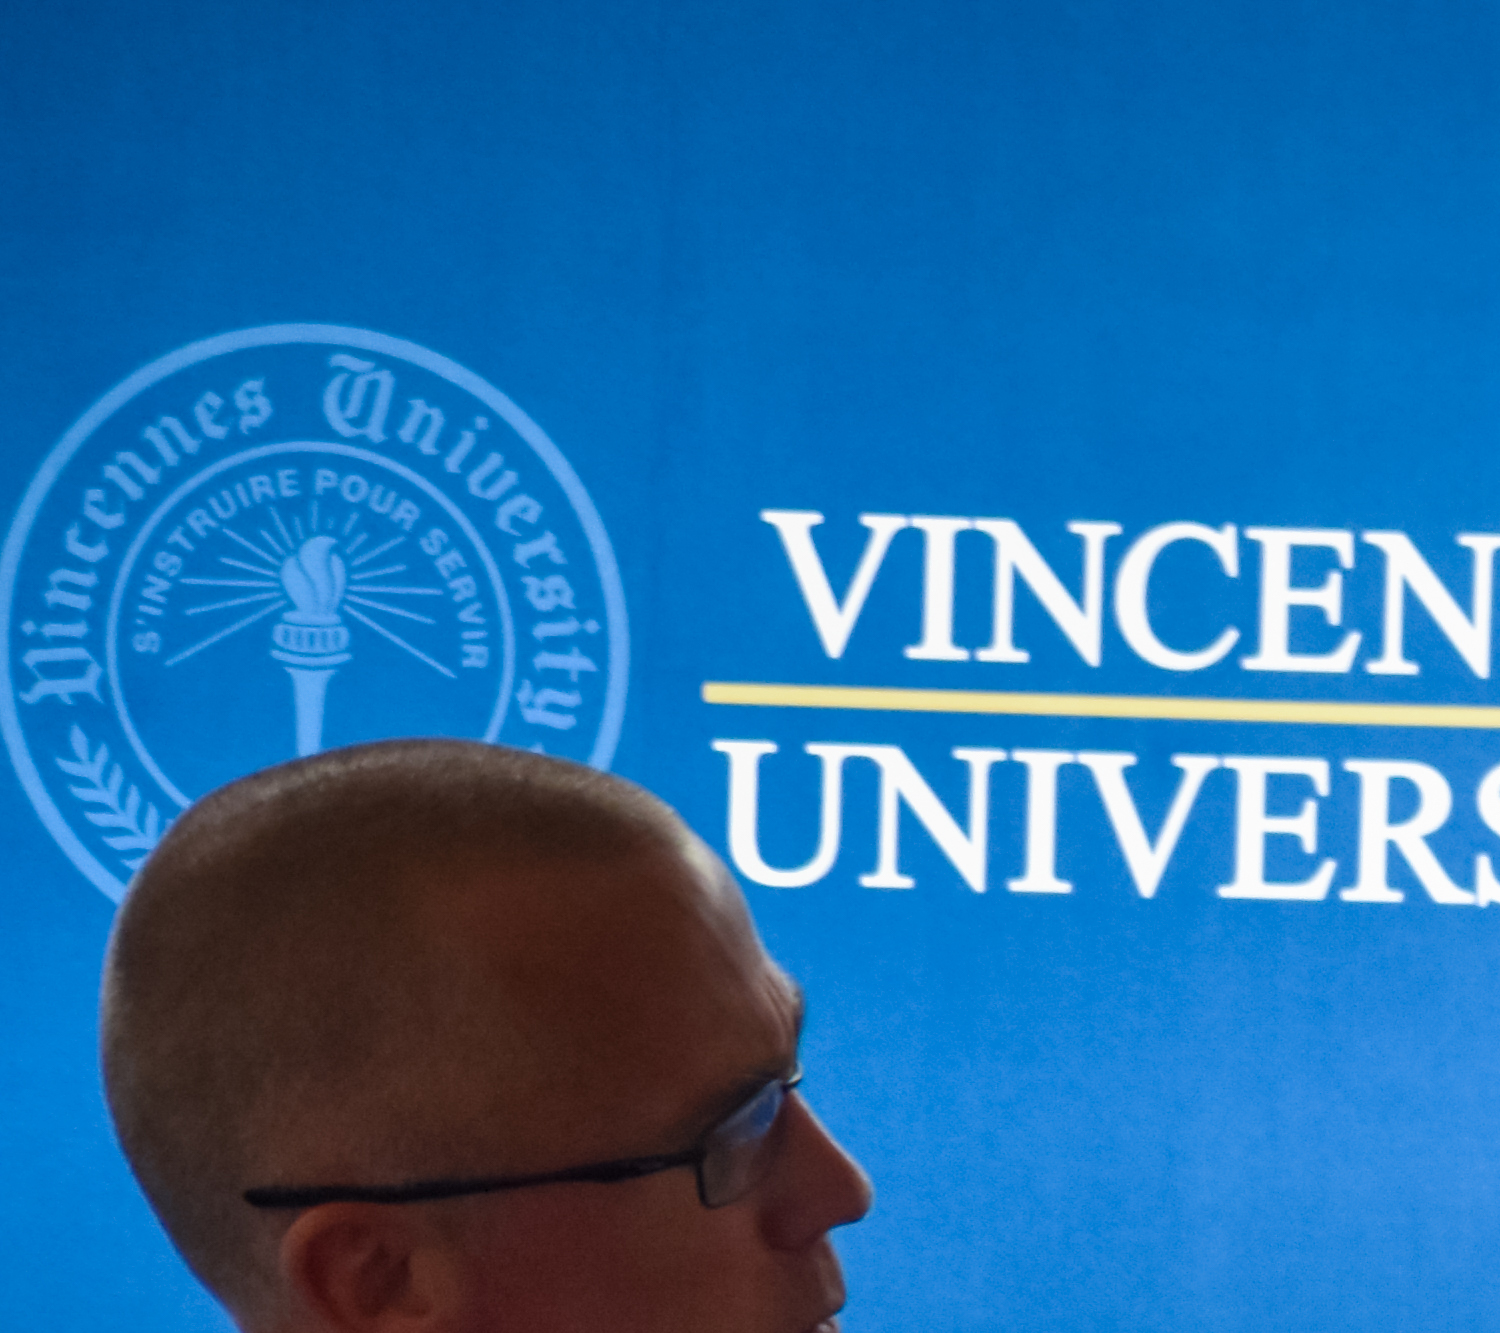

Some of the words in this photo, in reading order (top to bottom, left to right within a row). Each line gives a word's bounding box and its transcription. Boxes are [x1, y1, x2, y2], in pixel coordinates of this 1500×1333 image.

[19, 376, 273, 706] Vincennes
[321, 353, 600, 731] University
[133, 469, 300, 655] S'INSTRUIRE
[315, 469, 421, 533] POUR
[420, 526, 489, 669] SERVIR
